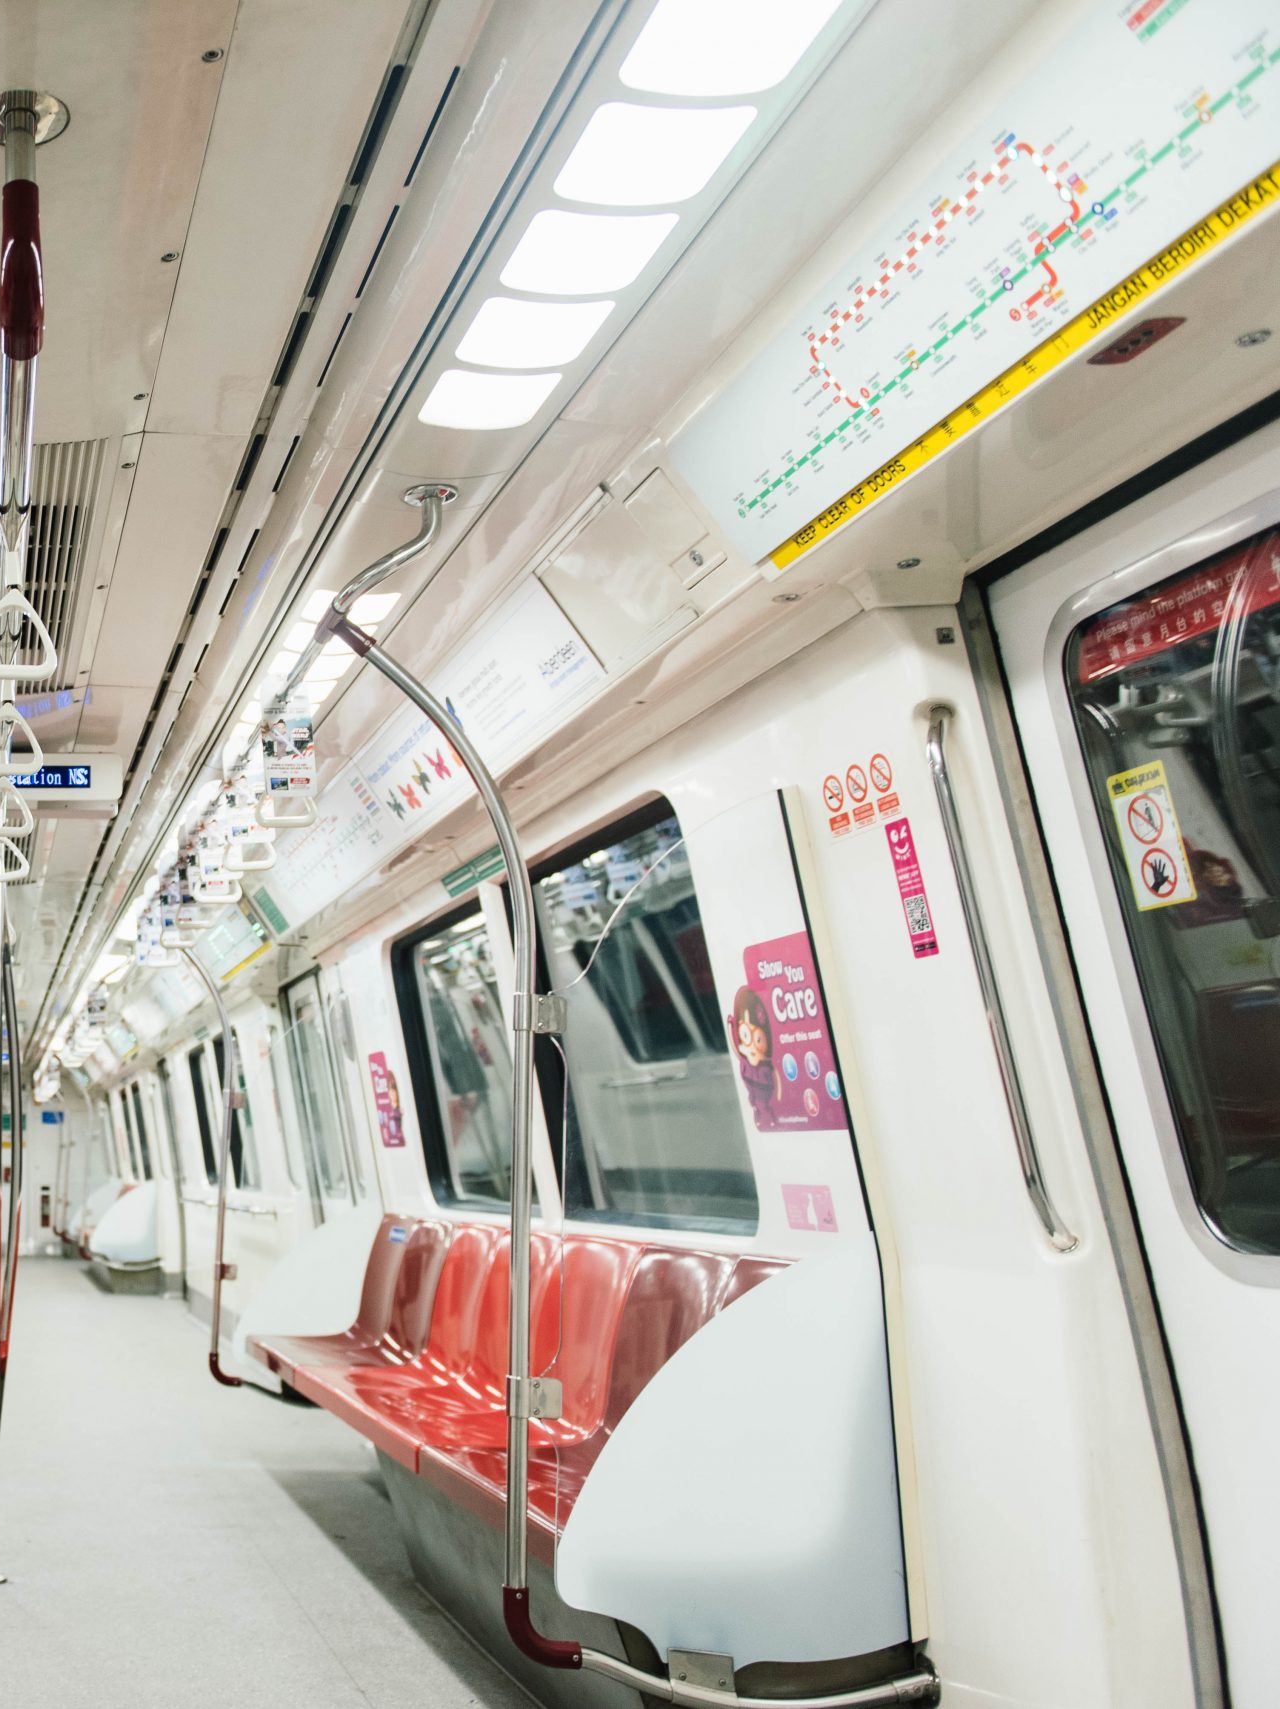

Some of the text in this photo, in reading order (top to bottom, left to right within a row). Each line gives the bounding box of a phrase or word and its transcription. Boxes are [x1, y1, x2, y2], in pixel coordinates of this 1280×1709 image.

[1086, 172, 1280, 329] JANGAN BERDIRI DEKAT
[793, 460, 906, 547] KEEP CLEAR OF DOORS
[1096, 619, 1129, 642] Please
[1130, 607, 1156, 629] mind
[1157, 598, 1175, 614] the
[757, 960, 783, 981] Show
[783, 965, 805, 985] You
[771, 986, 818, 1023] Care
[779, 1030, 822, 1045] Offer this seat
